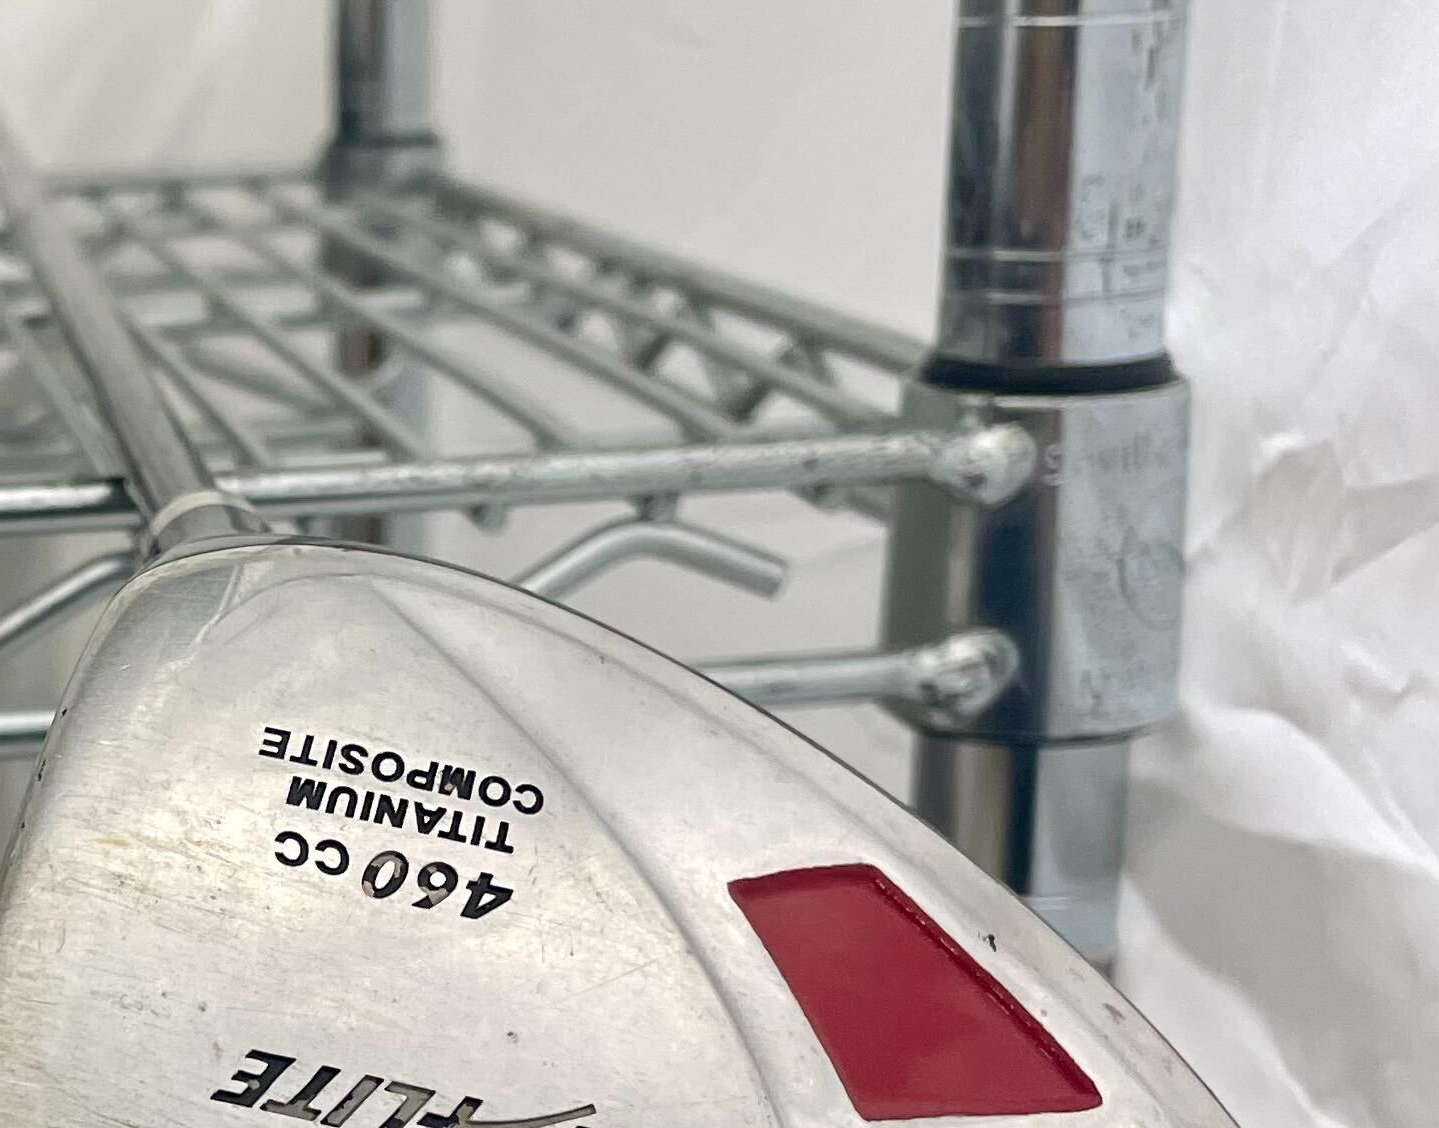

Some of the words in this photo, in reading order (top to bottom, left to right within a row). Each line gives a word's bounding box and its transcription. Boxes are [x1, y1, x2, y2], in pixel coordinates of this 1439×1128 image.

[258, 727, 544, 815] COMPOSITE
[286, 776, 514, 853] TITANIUM
[362, 850, 514, 919] 460
